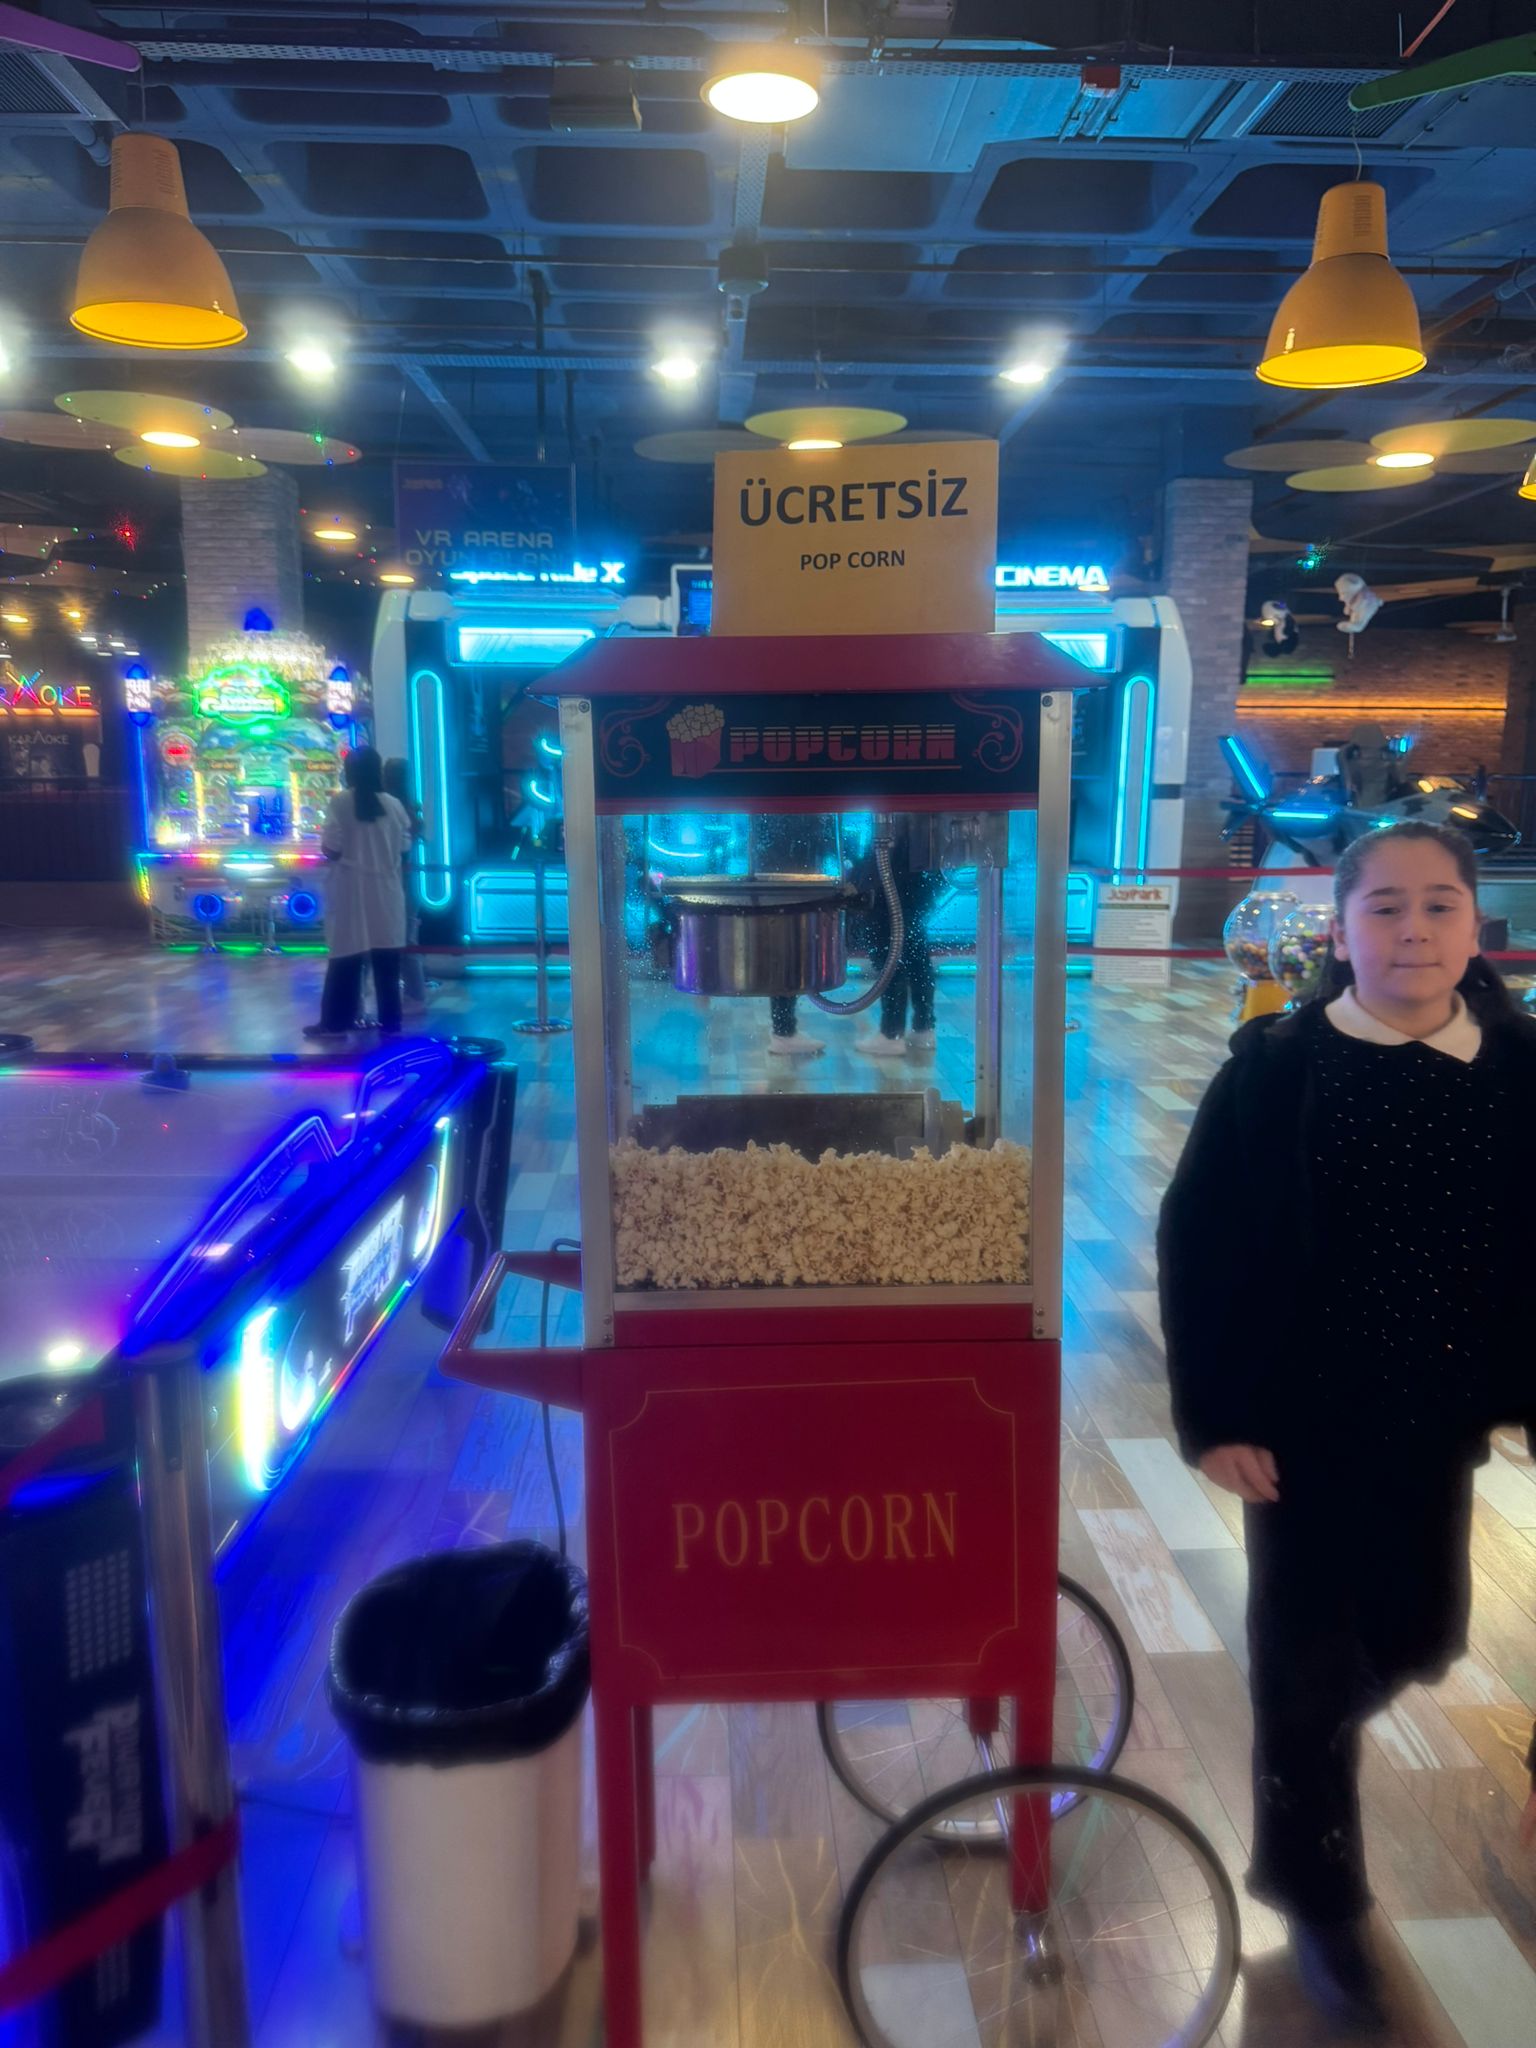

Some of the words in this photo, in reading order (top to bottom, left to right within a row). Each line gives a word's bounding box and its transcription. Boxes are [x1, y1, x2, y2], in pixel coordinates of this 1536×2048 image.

[740, 469, 968, 526] ÜCRETSİZ
[415, 529, 452, 547] VR
[464, 530, 553, 549] ARENA
[800, 553, 841, 571] POP
[847, 550, 906, 569] CORN
[994, 565, 1108, 587] CINEMA
[729, 724, 956, 762] POPCORN
[671, 1491, 958, 1569] POPCORN
